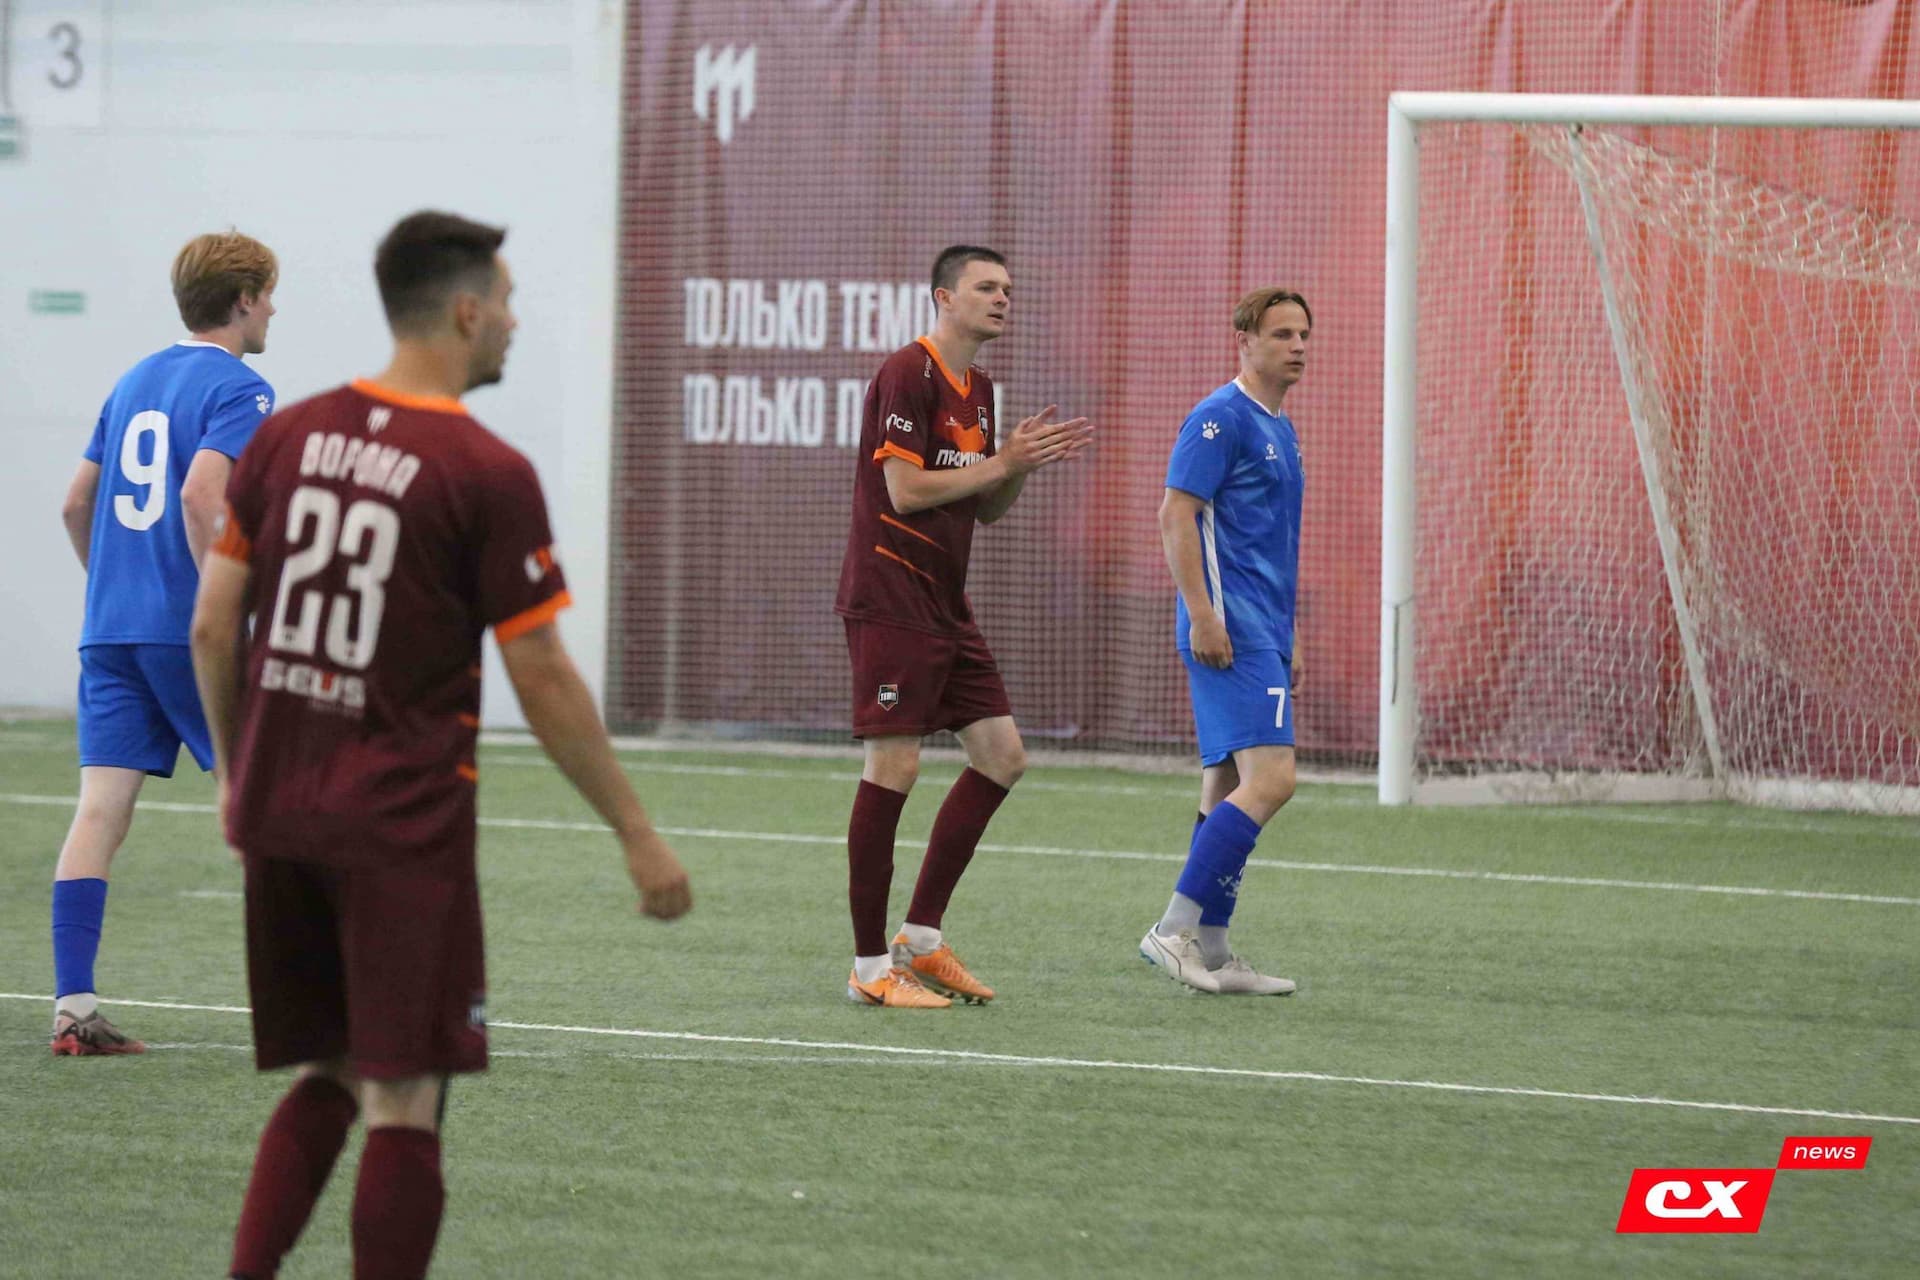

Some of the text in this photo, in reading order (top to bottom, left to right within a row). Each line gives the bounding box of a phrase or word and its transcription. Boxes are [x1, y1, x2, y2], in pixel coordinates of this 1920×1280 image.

[48, 21, 83, 89] 3
[113, 409, 169, 531] 9
[267, 485, 401, 670] 23
[1266, 686, 1287, 729] 7
